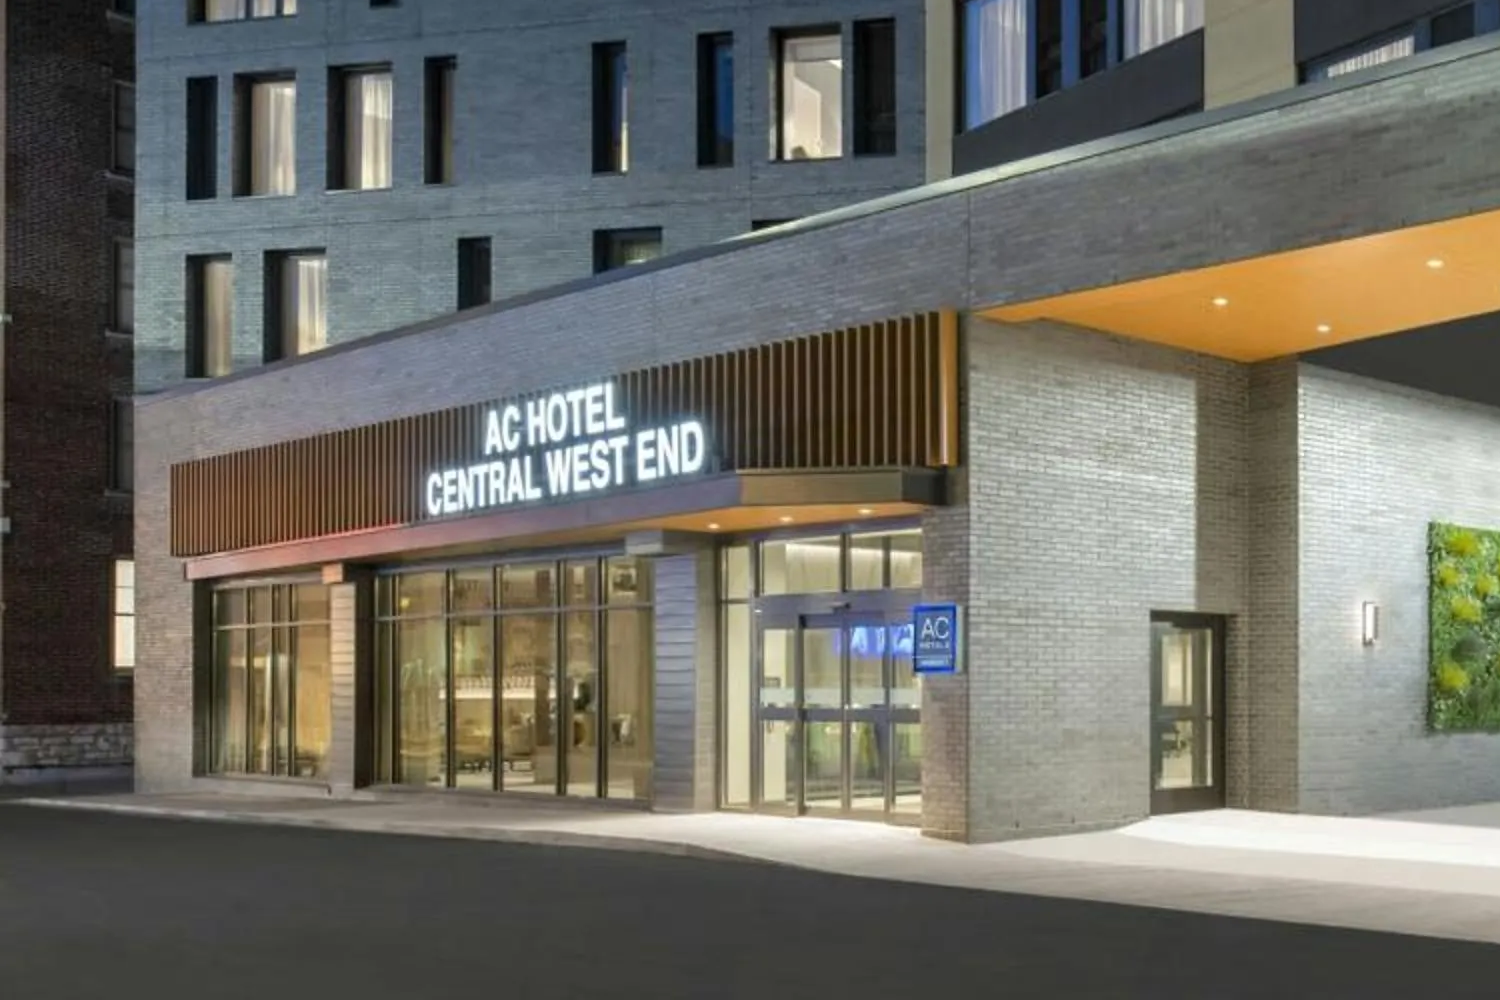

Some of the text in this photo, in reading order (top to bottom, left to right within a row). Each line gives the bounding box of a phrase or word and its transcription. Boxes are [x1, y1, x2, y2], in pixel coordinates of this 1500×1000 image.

[485, 382, 625, 454] AC HOTEL
[427, 421, 704, 516] CENTRAL WEST END
[921, 617, 950, 639] AC
